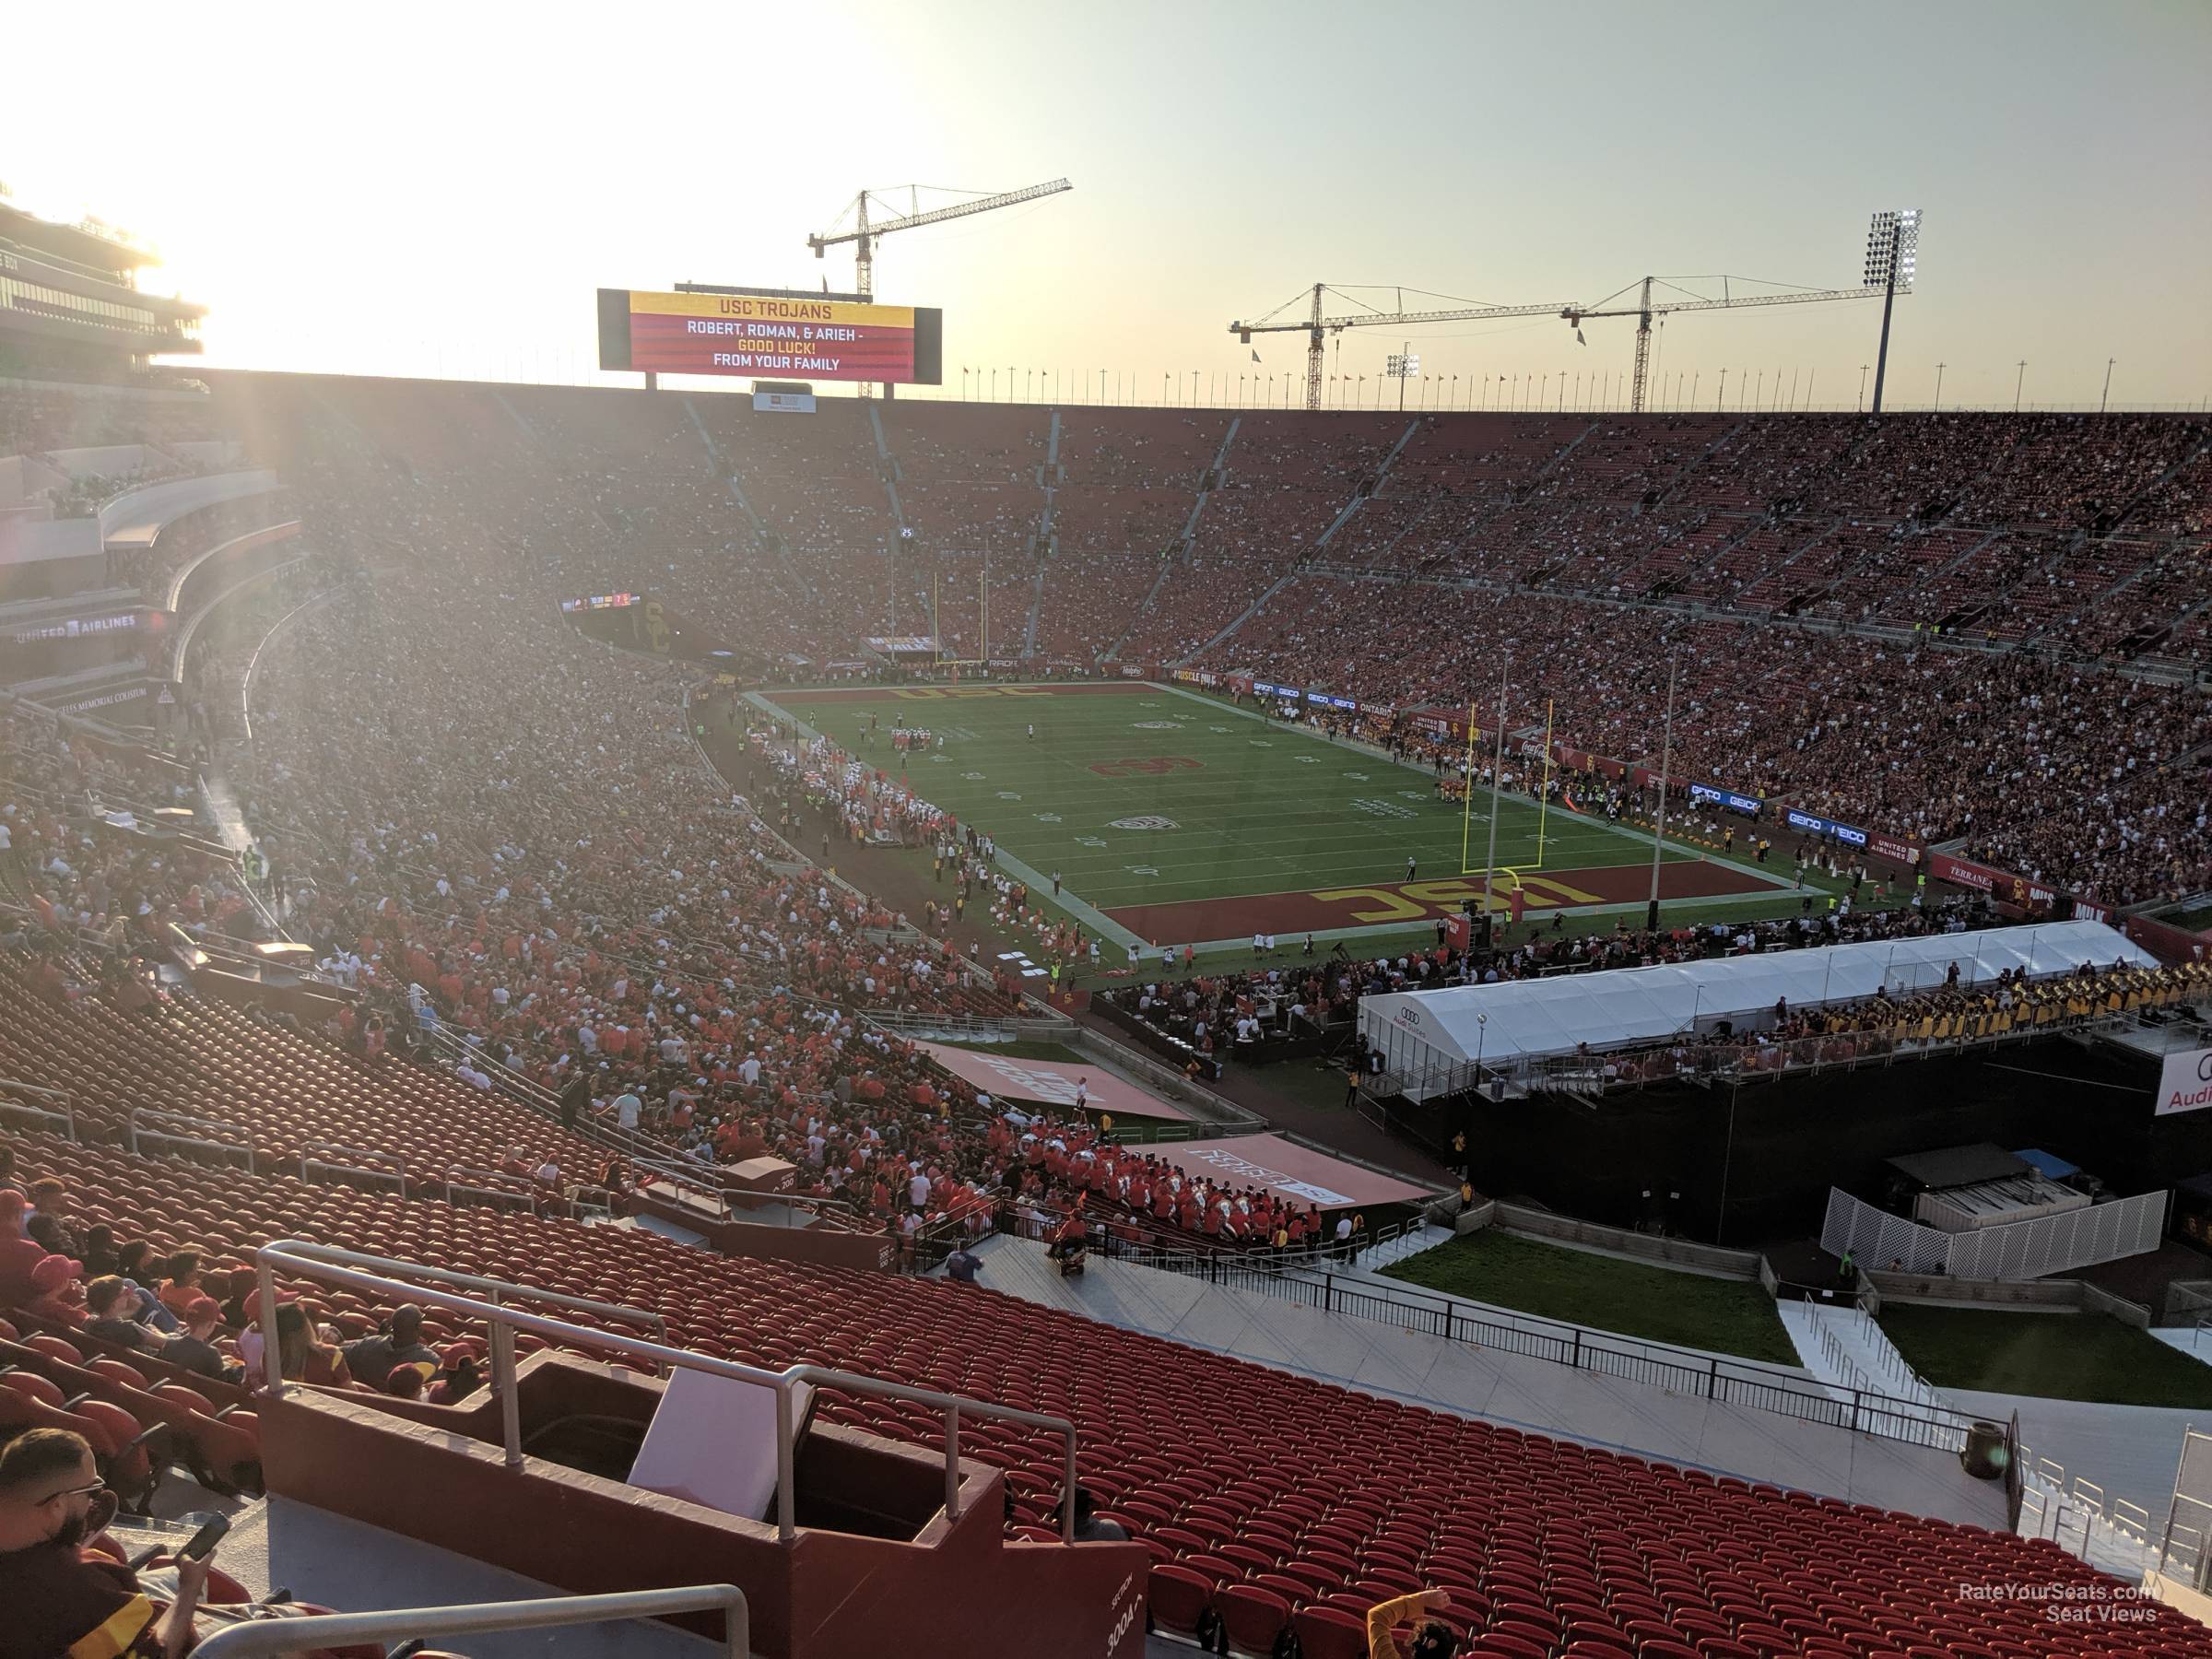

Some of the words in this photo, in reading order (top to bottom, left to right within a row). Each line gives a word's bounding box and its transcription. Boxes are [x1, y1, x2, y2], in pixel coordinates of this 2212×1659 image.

[721, 299, 752, 315] USC
[757, 300, 832, 320] TROJANS
[688, 320, 744, 336] ROBERT,
[747, 324, 800, 340] ROMAN,
[804, 328, 814, 340] &
[816, 327, 855, 342] ARIEH
[738, 338, 774, 353] GOOD
[778, 341, 816, 355] LUCK!
[713, 353, 752, 367] FROM
[756, 355, 791, 369] YOUR
[794, 357, 841, 371] FAMILY
[17, 627, 65, 644] UNITED
[81, 615, 135, 633] AIRLINES
[869, 636, 930, 644] MUSCLE
[1173, 669, 1200, 682] MUSCLE
[889, 686, 1055, 700] USC
[1278, 688, 1300, 698] GEICO
[1308, 693, 1329, 704] GEICO
[1334, 700, 1356, 710] GEICO
[1411, 721, 1438, 731] AIRLINES
[1417, 716, 1438, 726] UNITED
[1691, 784, 1722, 801] GEICO
[1789, 812, 1821, 830] GEICO
[1870, 844, 1906, 860] AIRLINES
[1878, 840, 1907, 853] UNITED
[1309, 876, 1608, 922] USC
[2075, 901, 2107, 922] MILK
[1393, 1016, 1407, 1028] Audi
[2168, 1086, 2212, 1109] Audi
[782, 1178, 794, 1190] 200
[1112, 1571, 1133, 1611] SECTION
[1107, 1603, 1135, 1658] 300A
